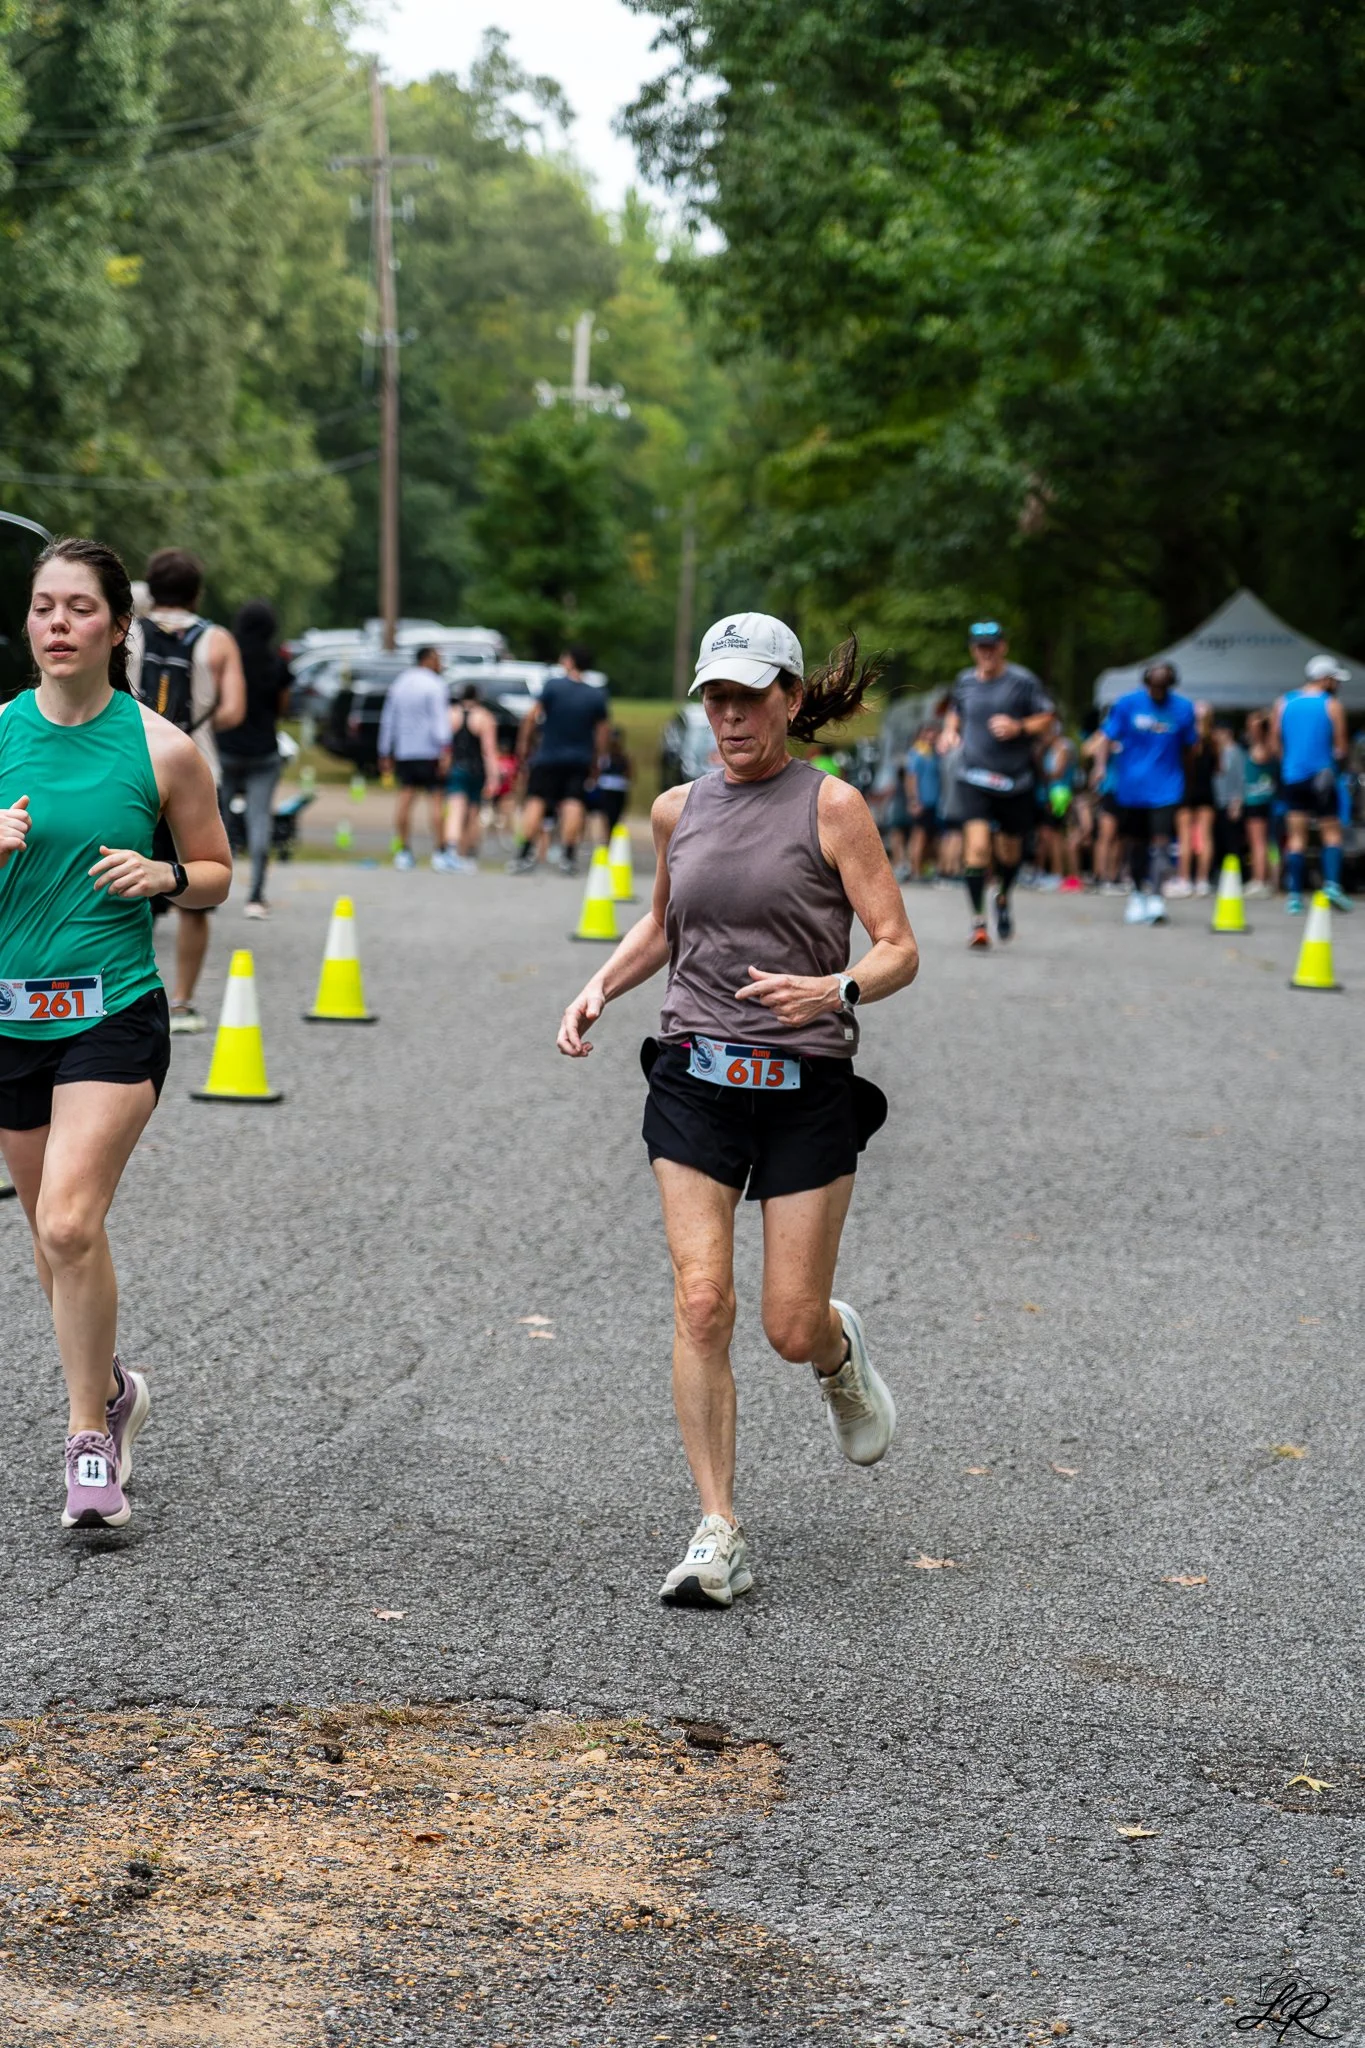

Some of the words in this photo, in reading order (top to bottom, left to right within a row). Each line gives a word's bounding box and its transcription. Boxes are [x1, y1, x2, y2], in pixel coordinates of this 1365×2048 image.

[51, 980, 70, 990] Amy
[28, 990, 85, 1019] 261
[752, 1049, 771, 1059] Amy
[726, 1058, 785, 1087] 615
